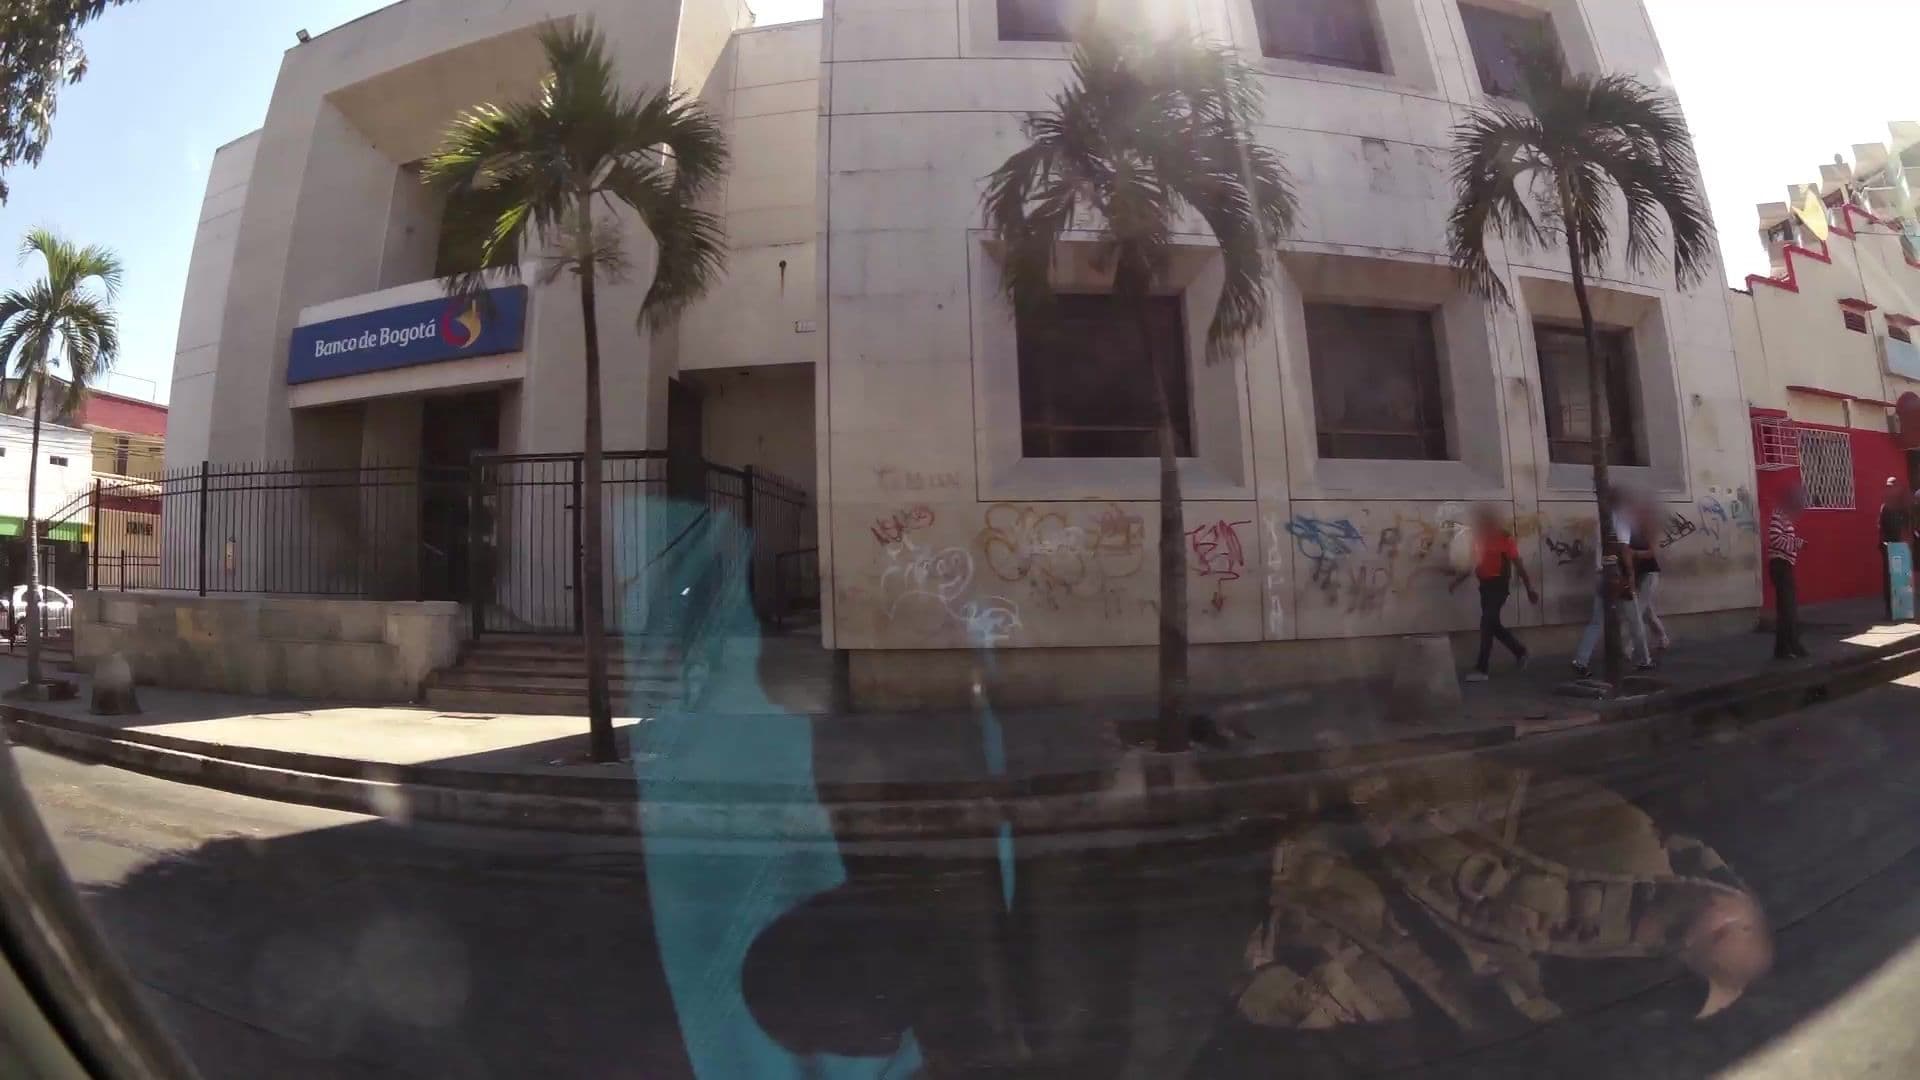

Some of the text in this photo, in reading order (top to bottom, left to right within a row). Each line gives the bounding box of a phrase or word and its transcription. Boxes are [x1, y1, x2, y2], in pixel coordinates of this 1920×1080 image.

[315, 318, 436, 357] Banco de Bogotá
